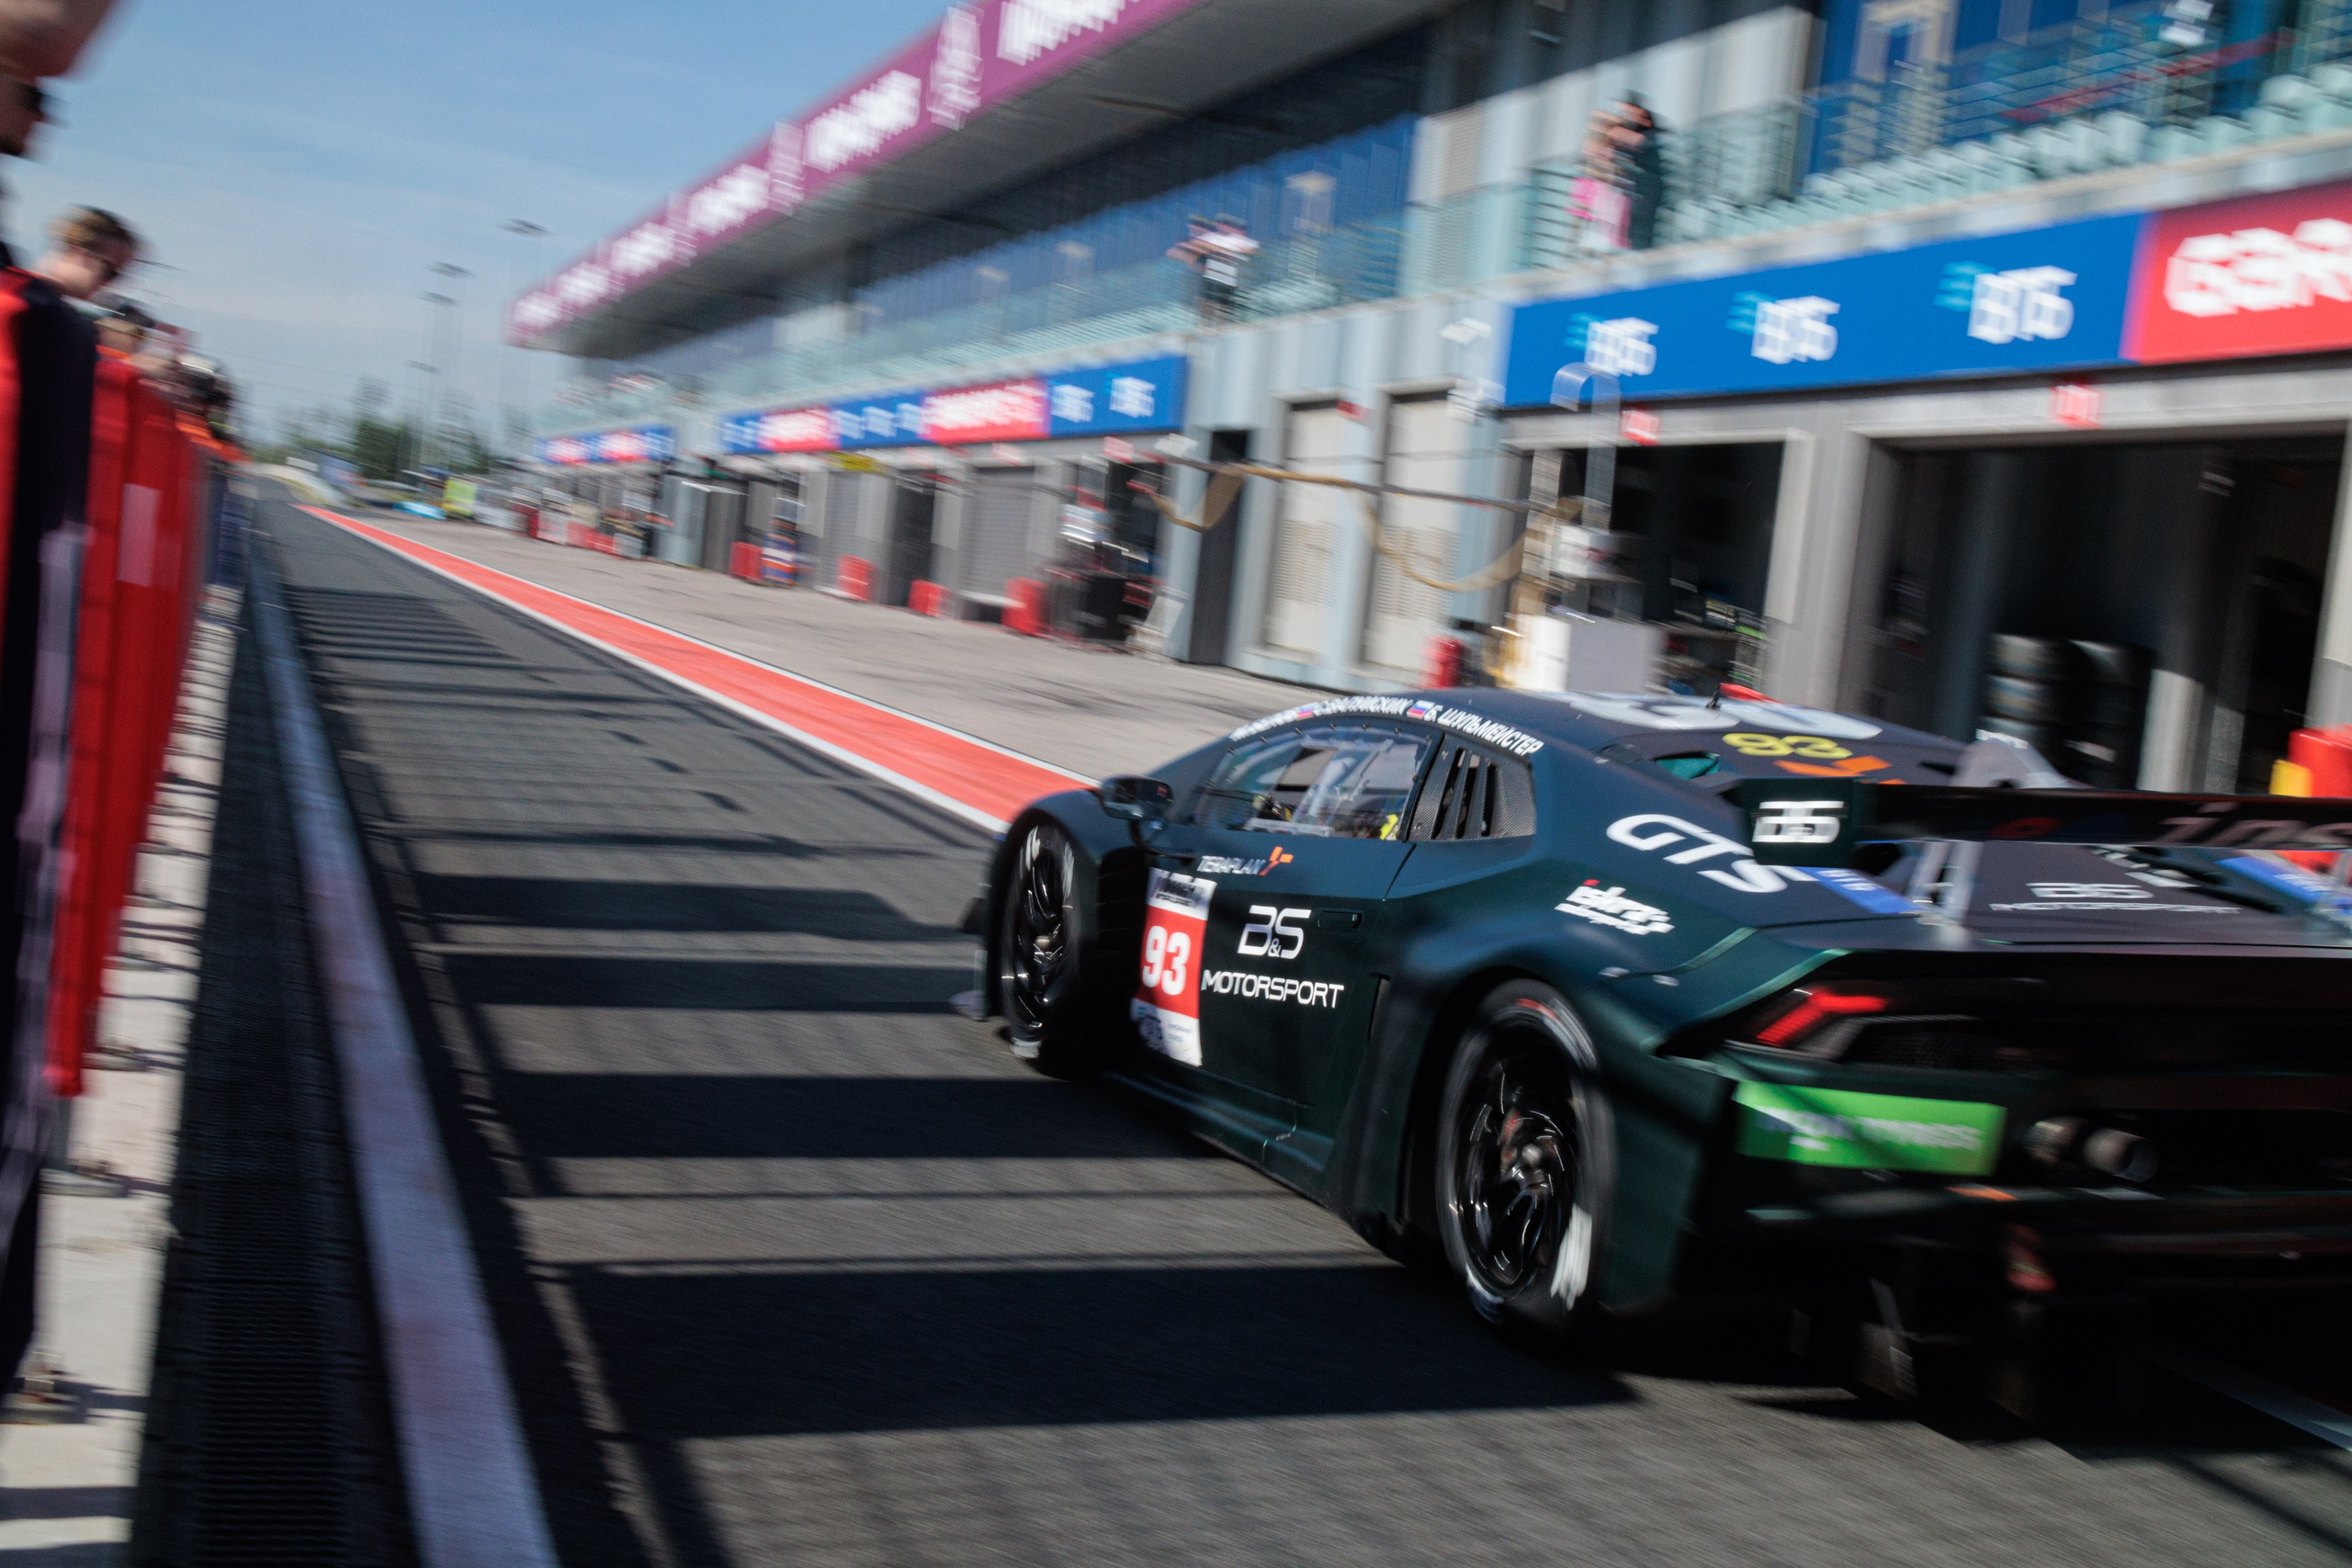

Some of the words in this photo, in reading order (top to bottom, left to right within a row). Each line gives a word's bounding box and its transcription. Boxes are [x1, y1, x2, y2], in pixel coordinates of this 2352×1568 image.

[1437, 707, 1544, 756] ШУЛЬМЕЙСТЕР
[1606, 814, 1820, 893] GTS
[1237, 905, 1312, 959] B&S
[1142, 925, 1191, 996] 93
[1201, 969, 1345, 1009] MOTORSPORT
